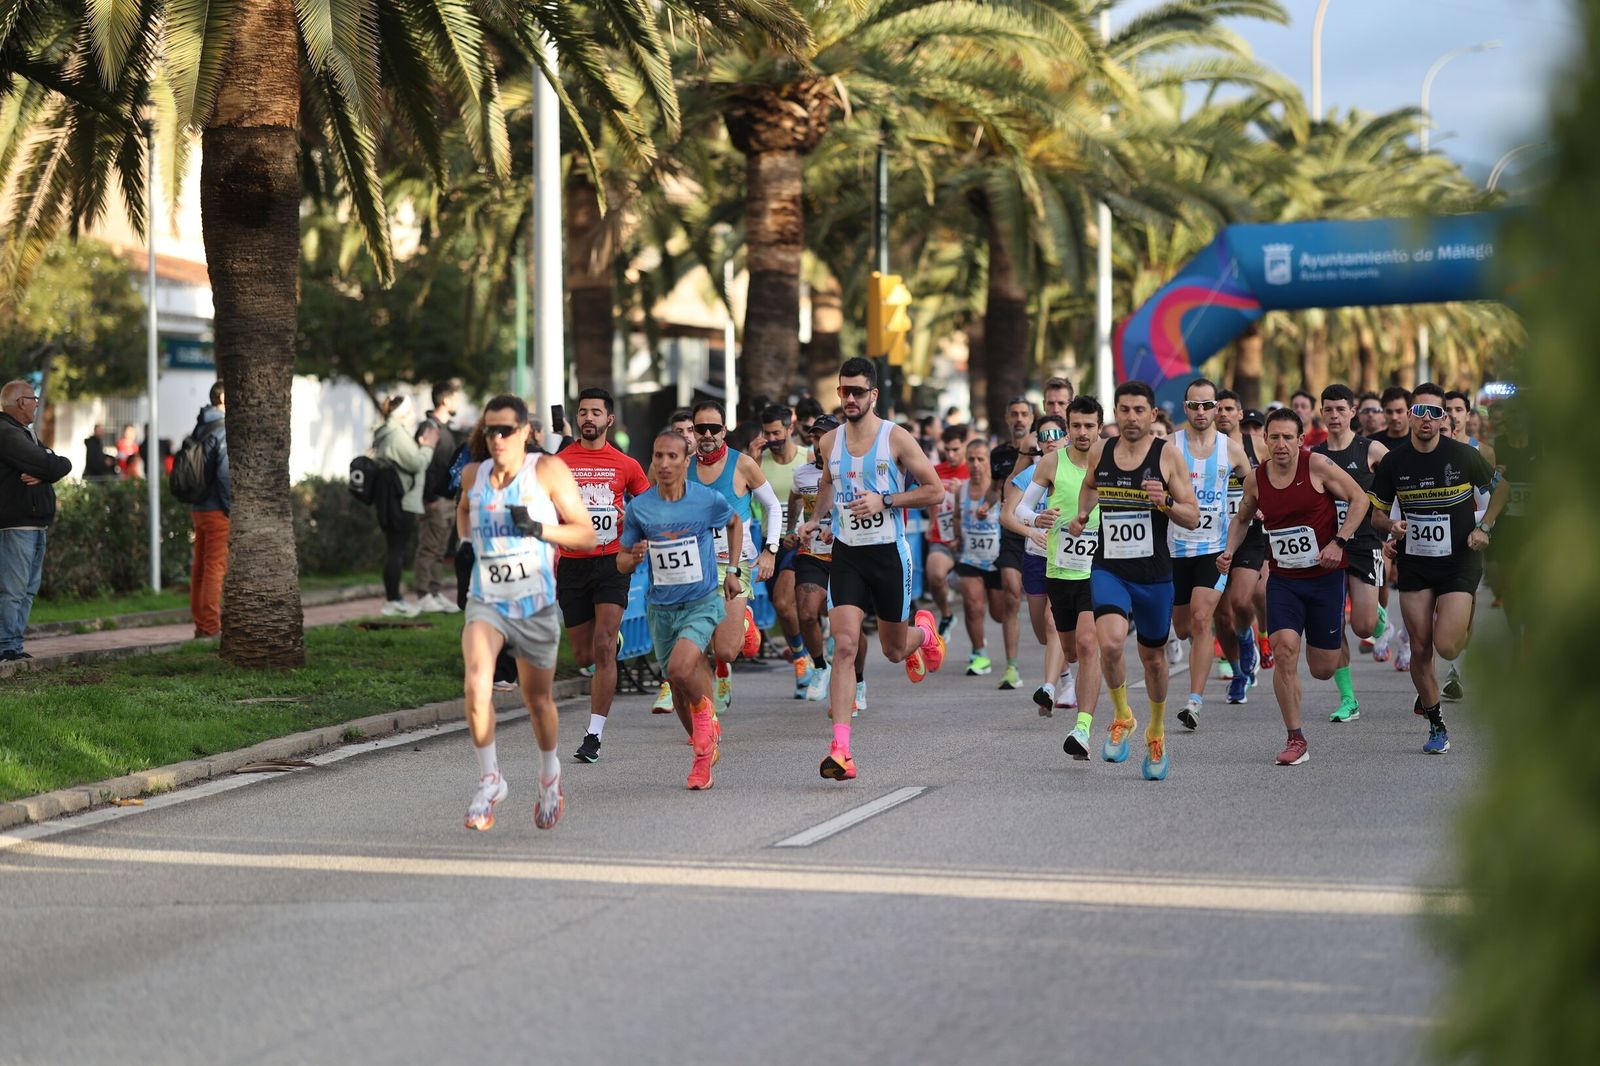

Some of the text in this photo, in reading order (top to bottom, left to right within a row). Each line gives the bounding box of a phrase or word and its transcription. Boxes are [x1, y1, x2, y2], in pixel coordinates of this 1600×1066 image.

[1299, 243, 1494, 269] Ayuntamiento de Málaga
[1105, 490, 1133, 498] TRIATLÓN
[1409, 490, 1437, 499] TRIATLÓN
[849, 511, 884, 530] 369
[1109, 523, 1146, 542] 200
[1411, 524, 1445, 542] 340
[970, 538, 993, 550] 347
[1063, 537, 1097, 556] 262
[1276, 536, 1312, 555] 268
[656, 550, 694, 570] 151
[488, 562, 531, 584] 821
